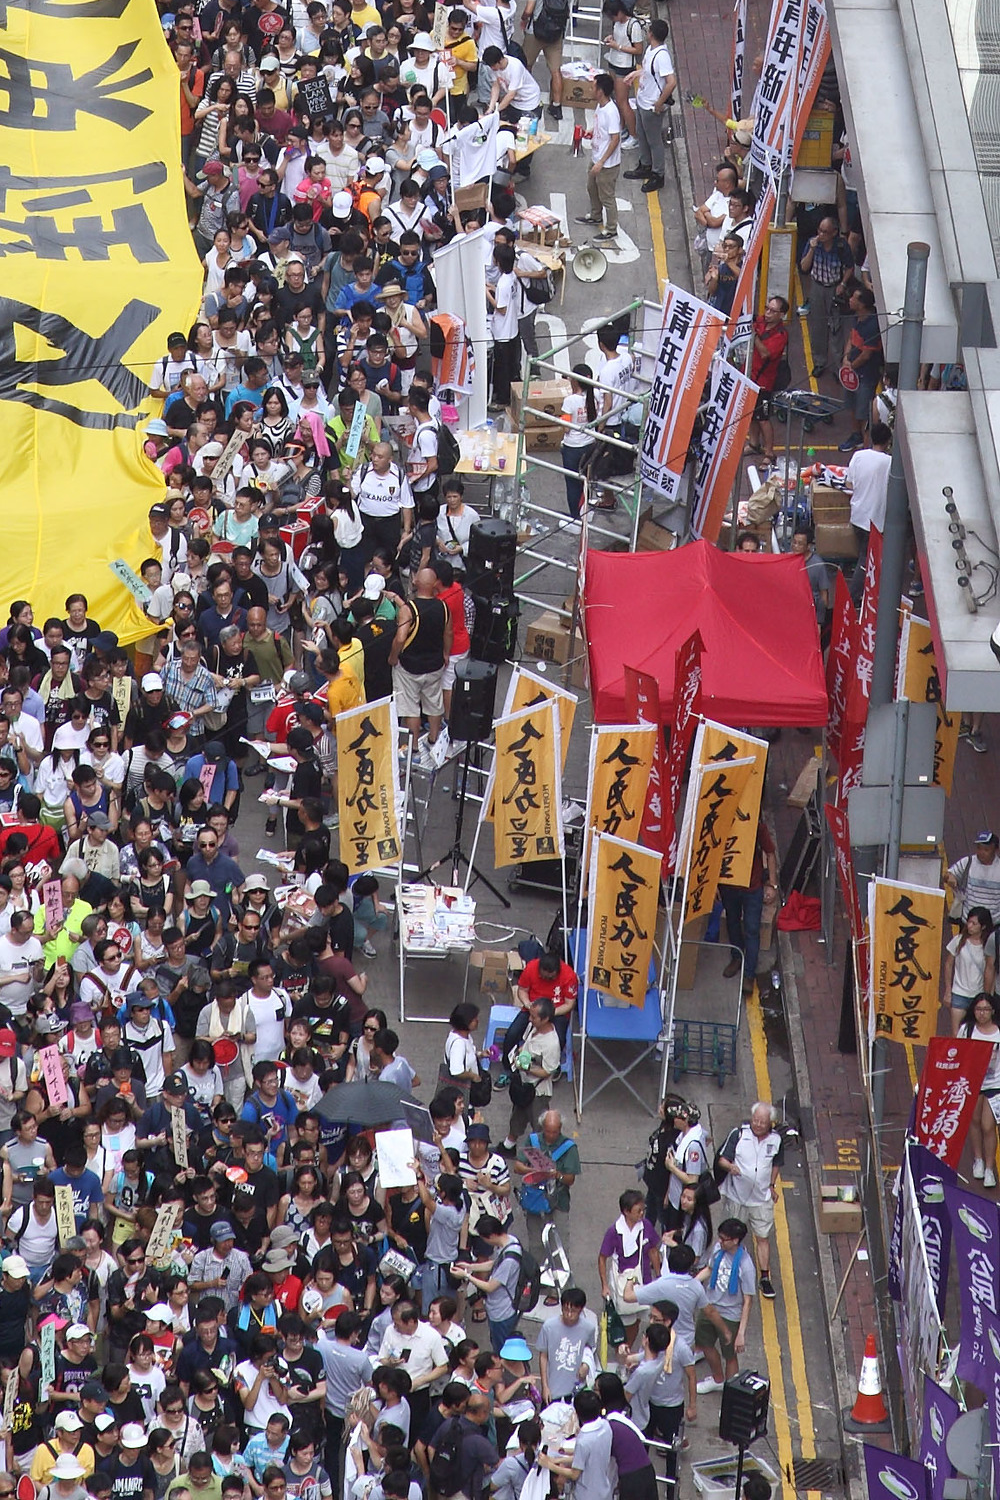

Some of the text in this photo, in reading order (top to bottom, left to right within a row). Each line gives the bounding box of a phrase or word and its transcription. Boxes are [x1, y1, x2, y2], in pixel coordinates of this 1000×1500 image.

[301, 79, 326, 94] JESUS
[305, 89, 325, 100] LAM
[309, 102, 327, 115] KEE
[643, 299, 696, 464] 青年新政
[684, 312, 713, 391] YOUNGSPIRATION
[723, 383, 750, 461] YOUNGSPIRATION
[366, 492, 393, 502] XANGO
[692, 773, 738, 913] 人民力量
[607, 852, 653, 997] 人民力量
[884, 894, 936, 1039] 人民力量
